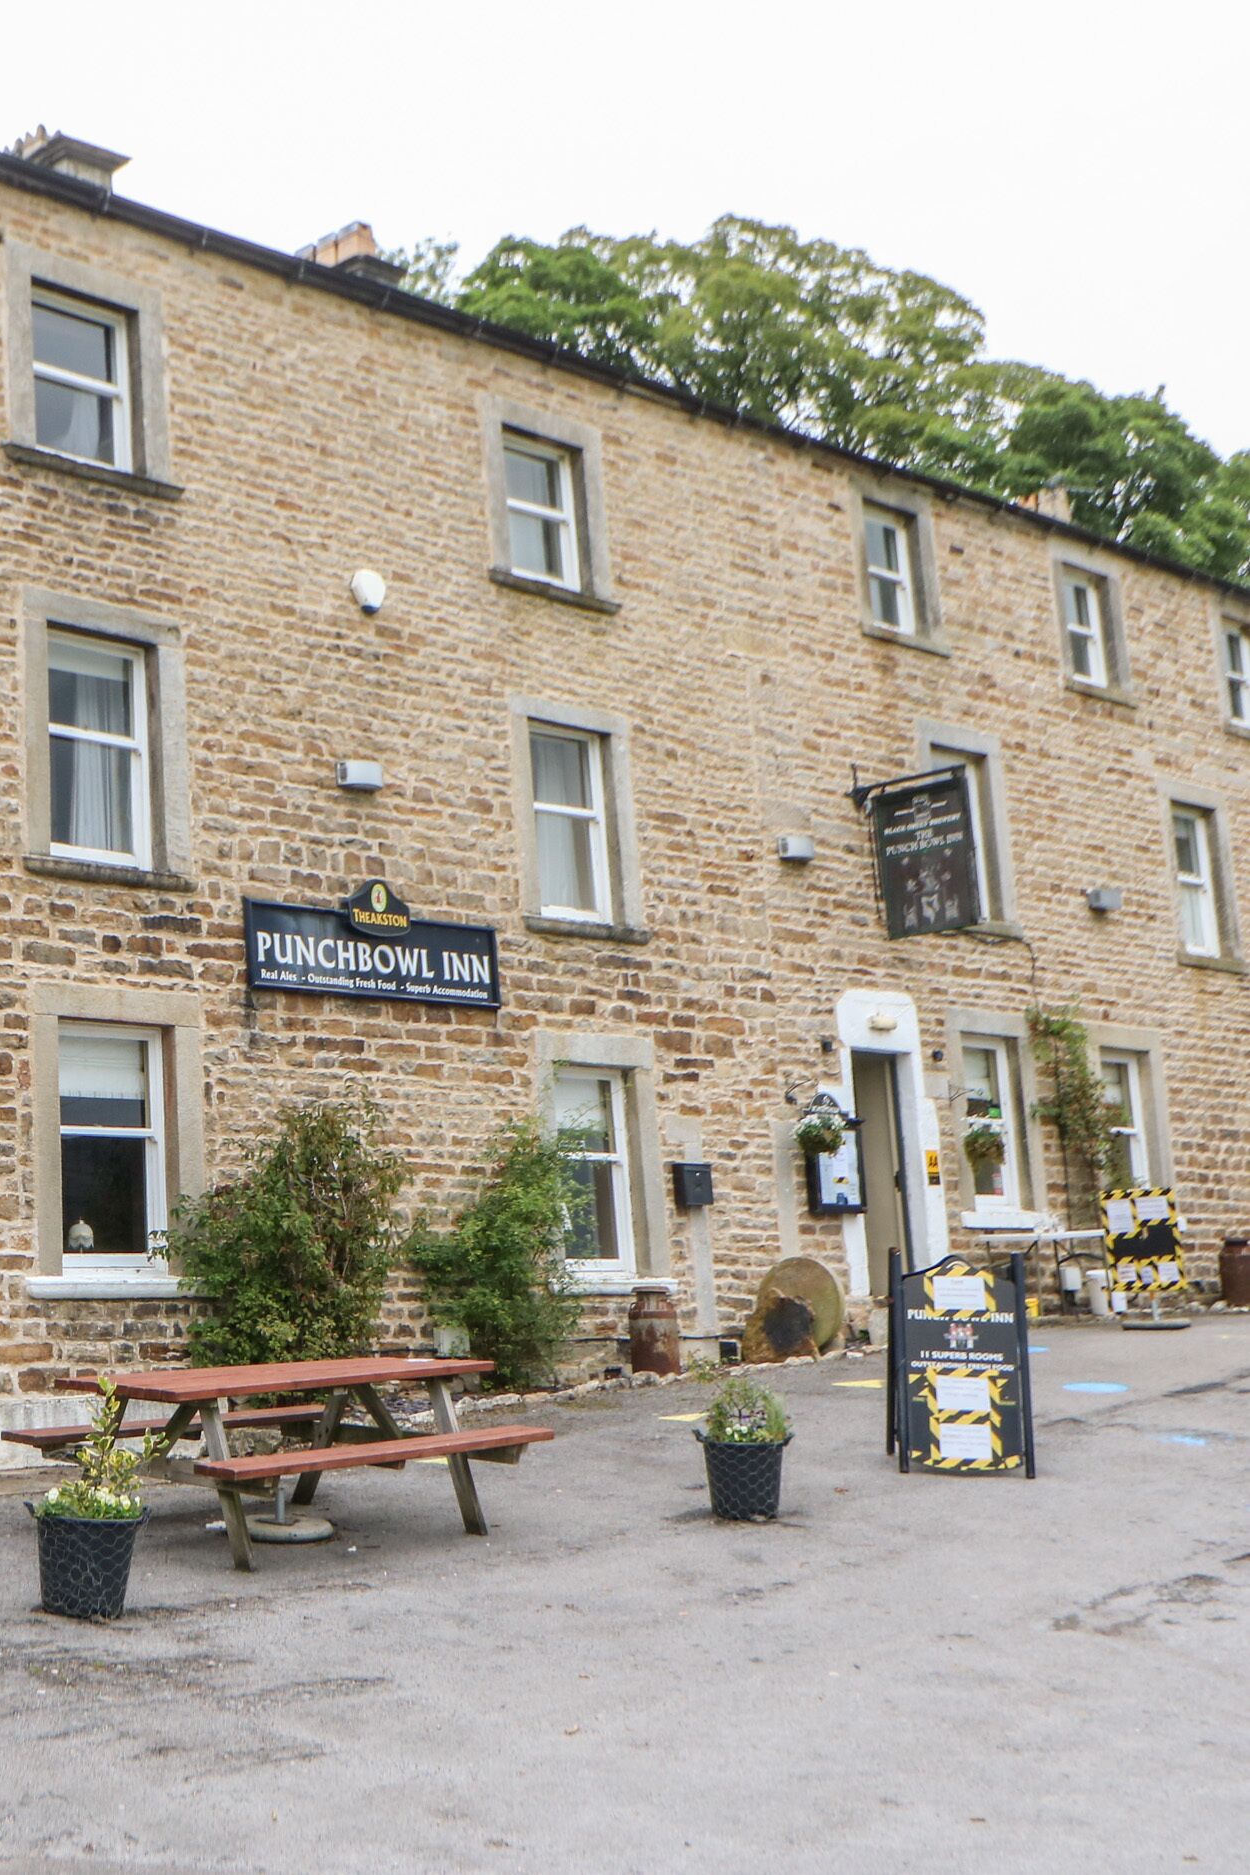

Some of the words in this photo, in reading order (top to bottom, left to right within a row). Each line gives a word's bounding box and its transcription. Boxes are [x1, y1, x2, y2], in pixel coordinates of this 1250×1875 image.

[886, 841, 919, 857] PUNCH
[919, 834, 945, 851] BOWL
[946, 831, 964, 845] INN
[914, 828, 934, 841] THE
[352, 907, 408, 928] THEAKSTON
[256, 931, 435, 979] PUNCHBOWL
[442, 951, 491, 985] INN
[260, 968, 278, 980] Real
[280, 970, 298, 982] Ales
[307, 973, 354, 988] Outstanding
[355, 977, 376, 989] Fresh
[377, 979, 397, 991] Food
[405, 982, 431, 994] Superb
[432, 985, 489, 999] Accommodation
[990, 1312, 1015, 1323] INN
[931, 1350, 968, 1361] SUPERB
[968, 1352, 1004, 1363] ROOMS
